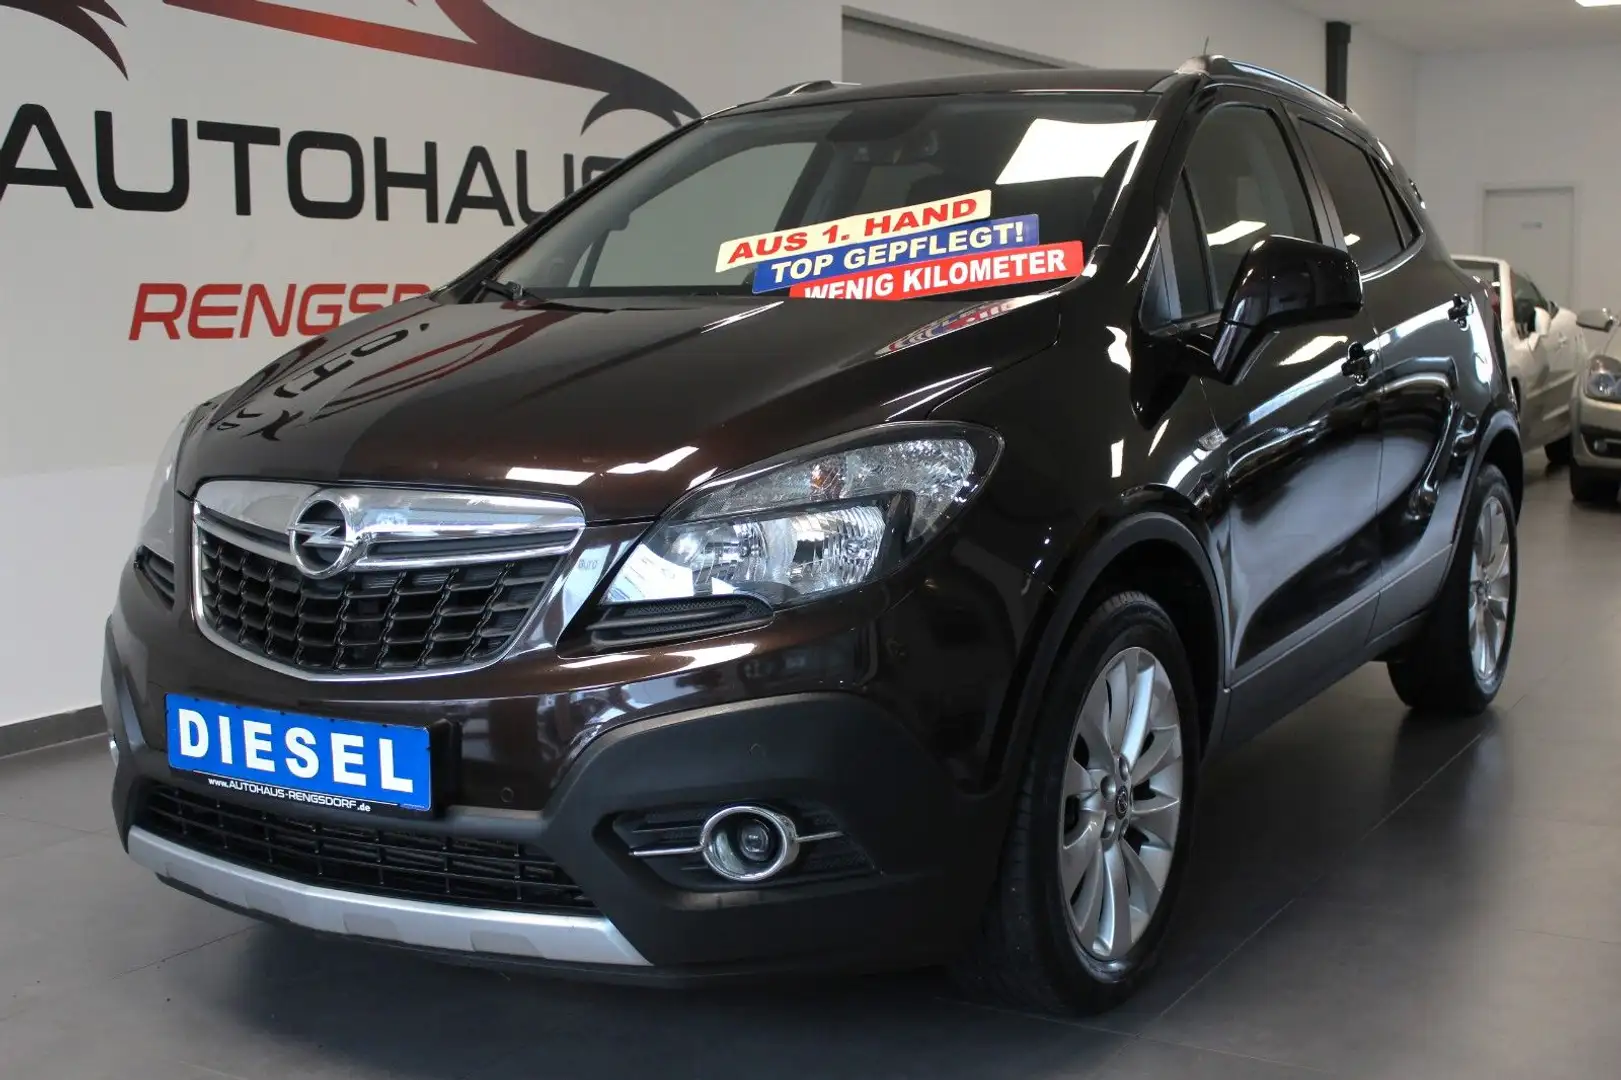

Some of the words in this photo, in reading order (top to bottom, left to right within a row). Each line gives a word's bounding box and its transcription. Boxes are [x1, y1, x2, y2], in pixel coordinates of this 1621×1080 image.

[727, 231, 807, 264] AUS
[822, 224, 850, 245] 1.
[864, 198, 977, 236] HAND
[770, 253, 833, 283] TOP
[843, 221, 1024, 270] GEPFLEGT!
[804, 273, 894, 299] WENIG
[903, 249, 1066, 292] KILOMETER
[178, 708, 413, 793] DIESEL
[207, 778, 371, 812] www.AUTOHAUS-RENGSDORF.de
